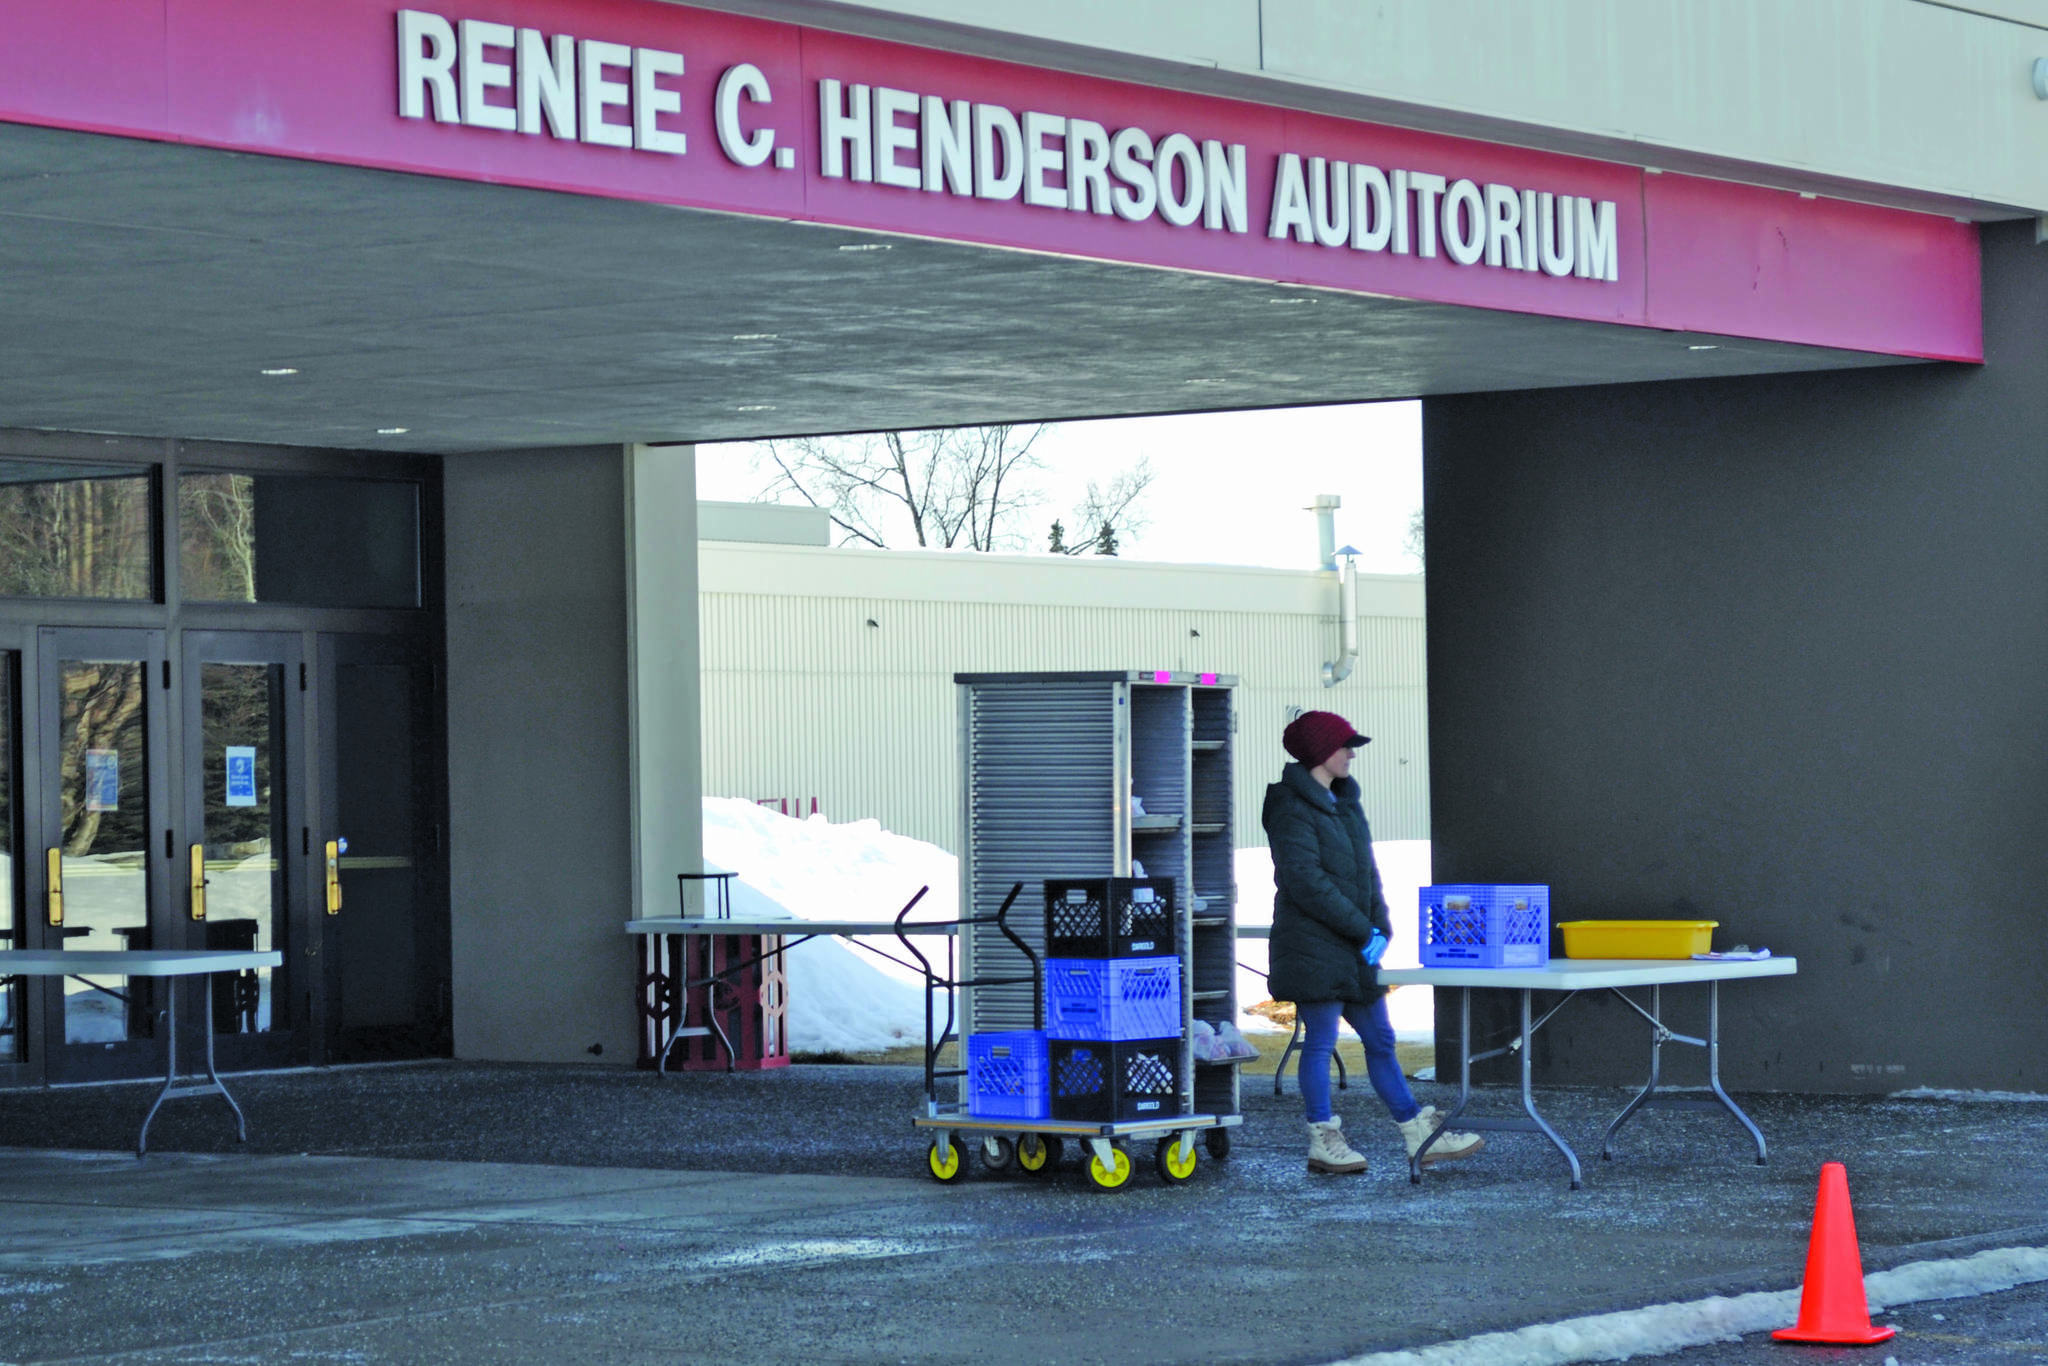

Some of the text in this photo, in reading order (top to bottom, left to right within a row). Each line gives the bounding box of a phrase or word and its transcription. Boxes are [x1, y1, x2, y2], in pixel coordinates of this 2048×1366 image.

[397, 9, 1619, 282] RENEE C. HENDERSON AUDITORIUM
